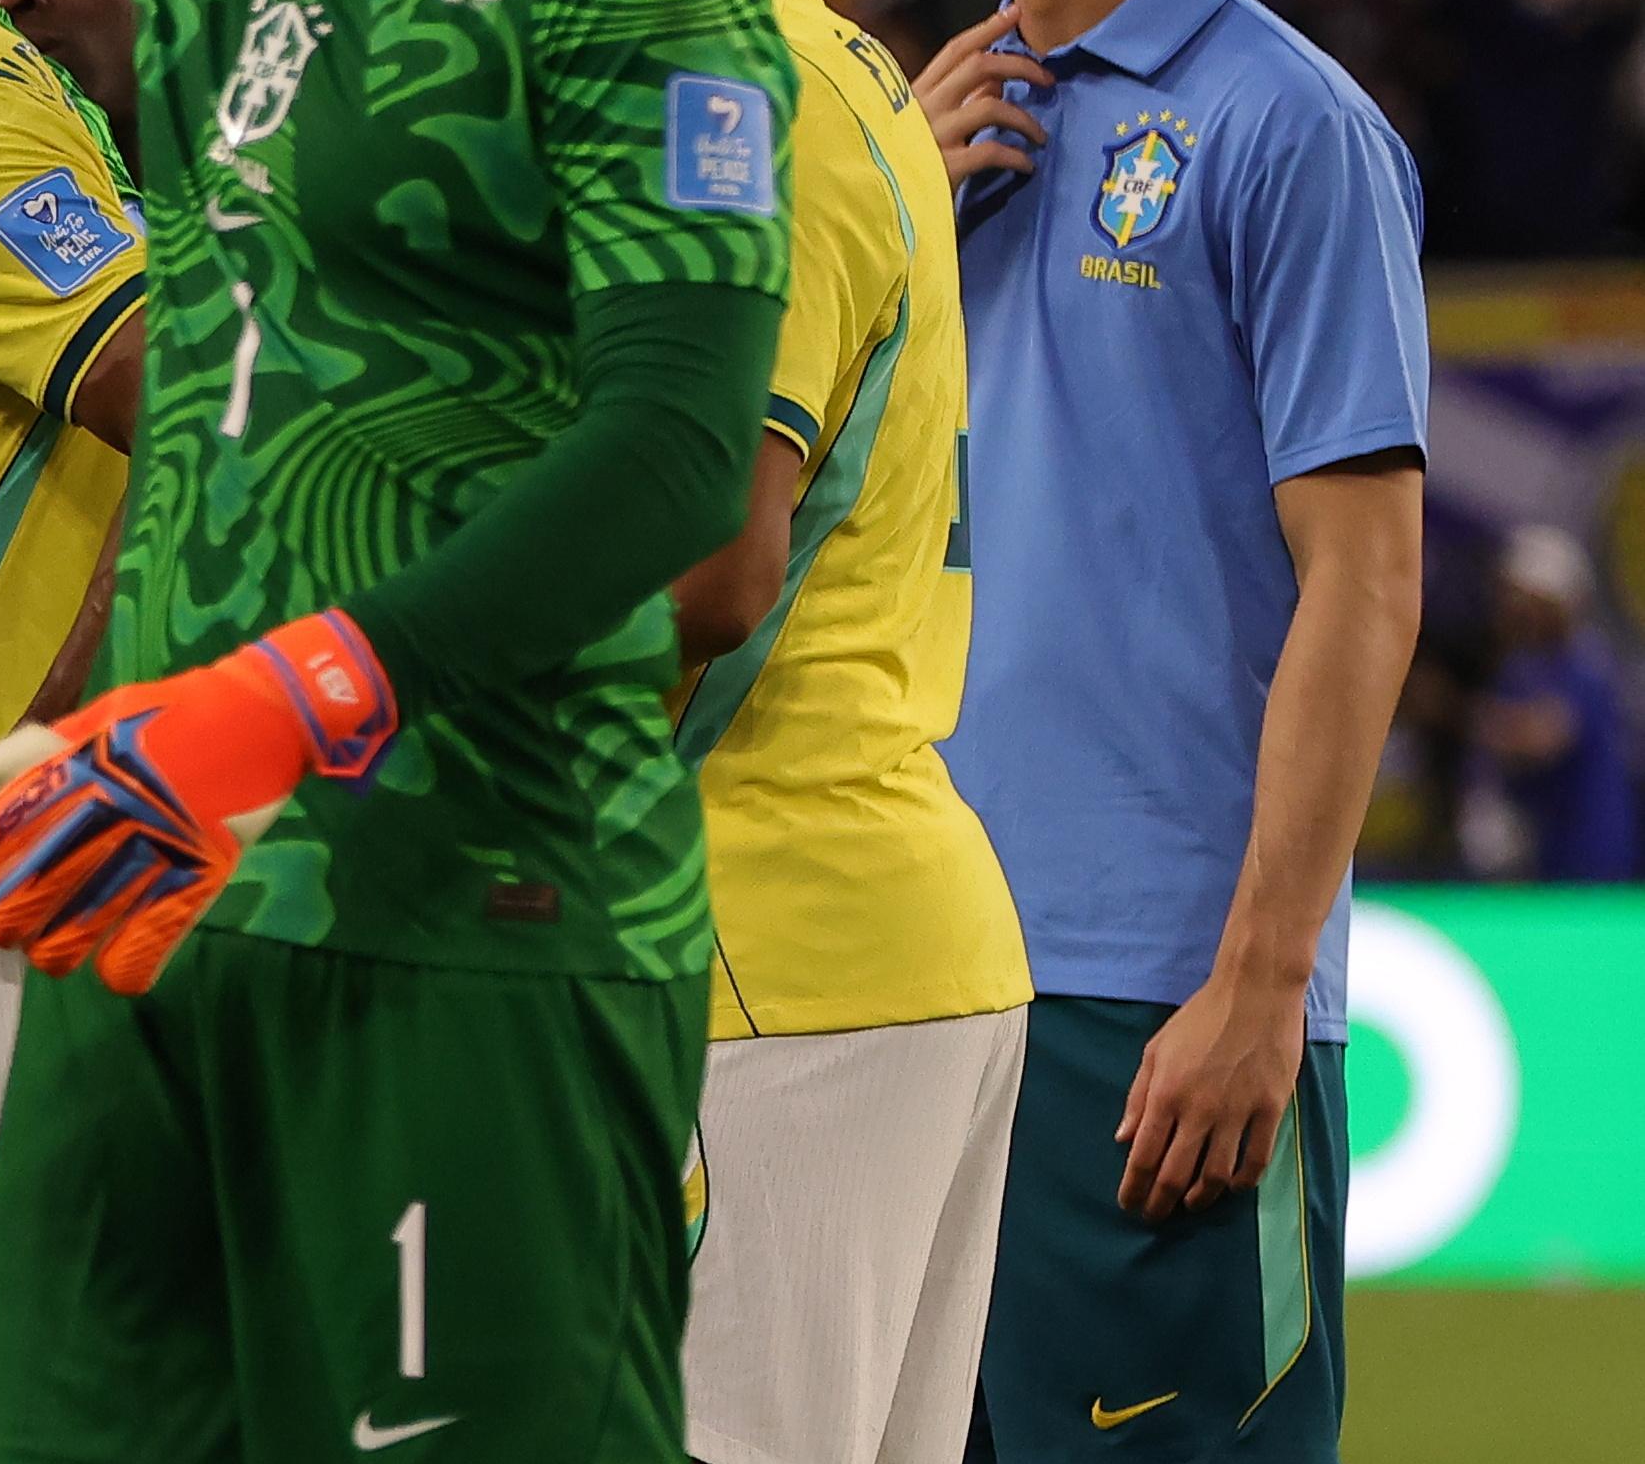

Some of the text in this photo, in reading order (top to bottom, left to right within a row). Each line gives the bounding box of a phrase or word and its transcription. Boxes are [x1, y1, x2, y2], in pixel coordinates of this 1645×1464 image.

[1122, 177, 1154, 196] CBF
[1080, 254, 1163, 290] BRASIL
[217, 280, 262, 440] 1
[390, 1200, 427, 1380] 1
